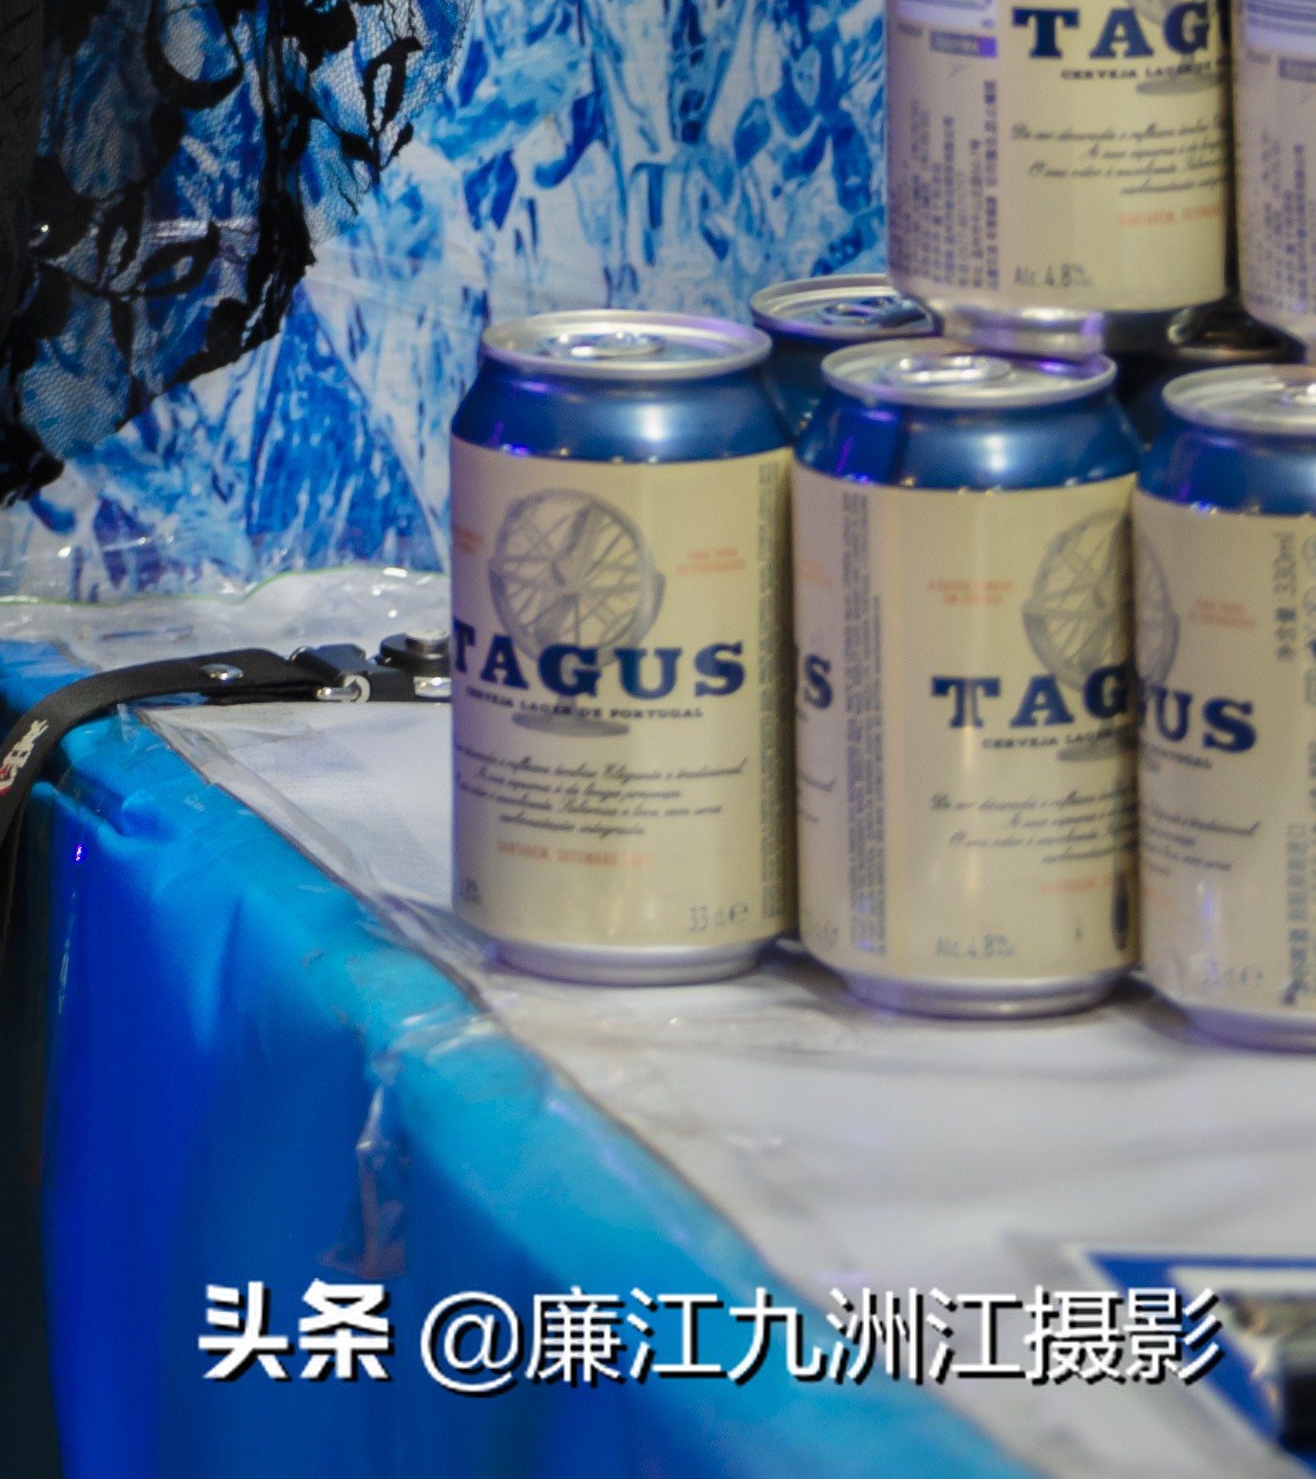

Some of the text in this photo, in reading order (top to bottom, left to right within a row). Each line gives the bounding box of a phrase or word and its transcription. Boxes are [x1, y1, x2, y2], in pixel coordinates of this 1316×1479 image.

[1012, 0, 1224, 60] TAG
[452, 618, 747, 702] TAGUS
[932, 664, 1130, 730] TAG
